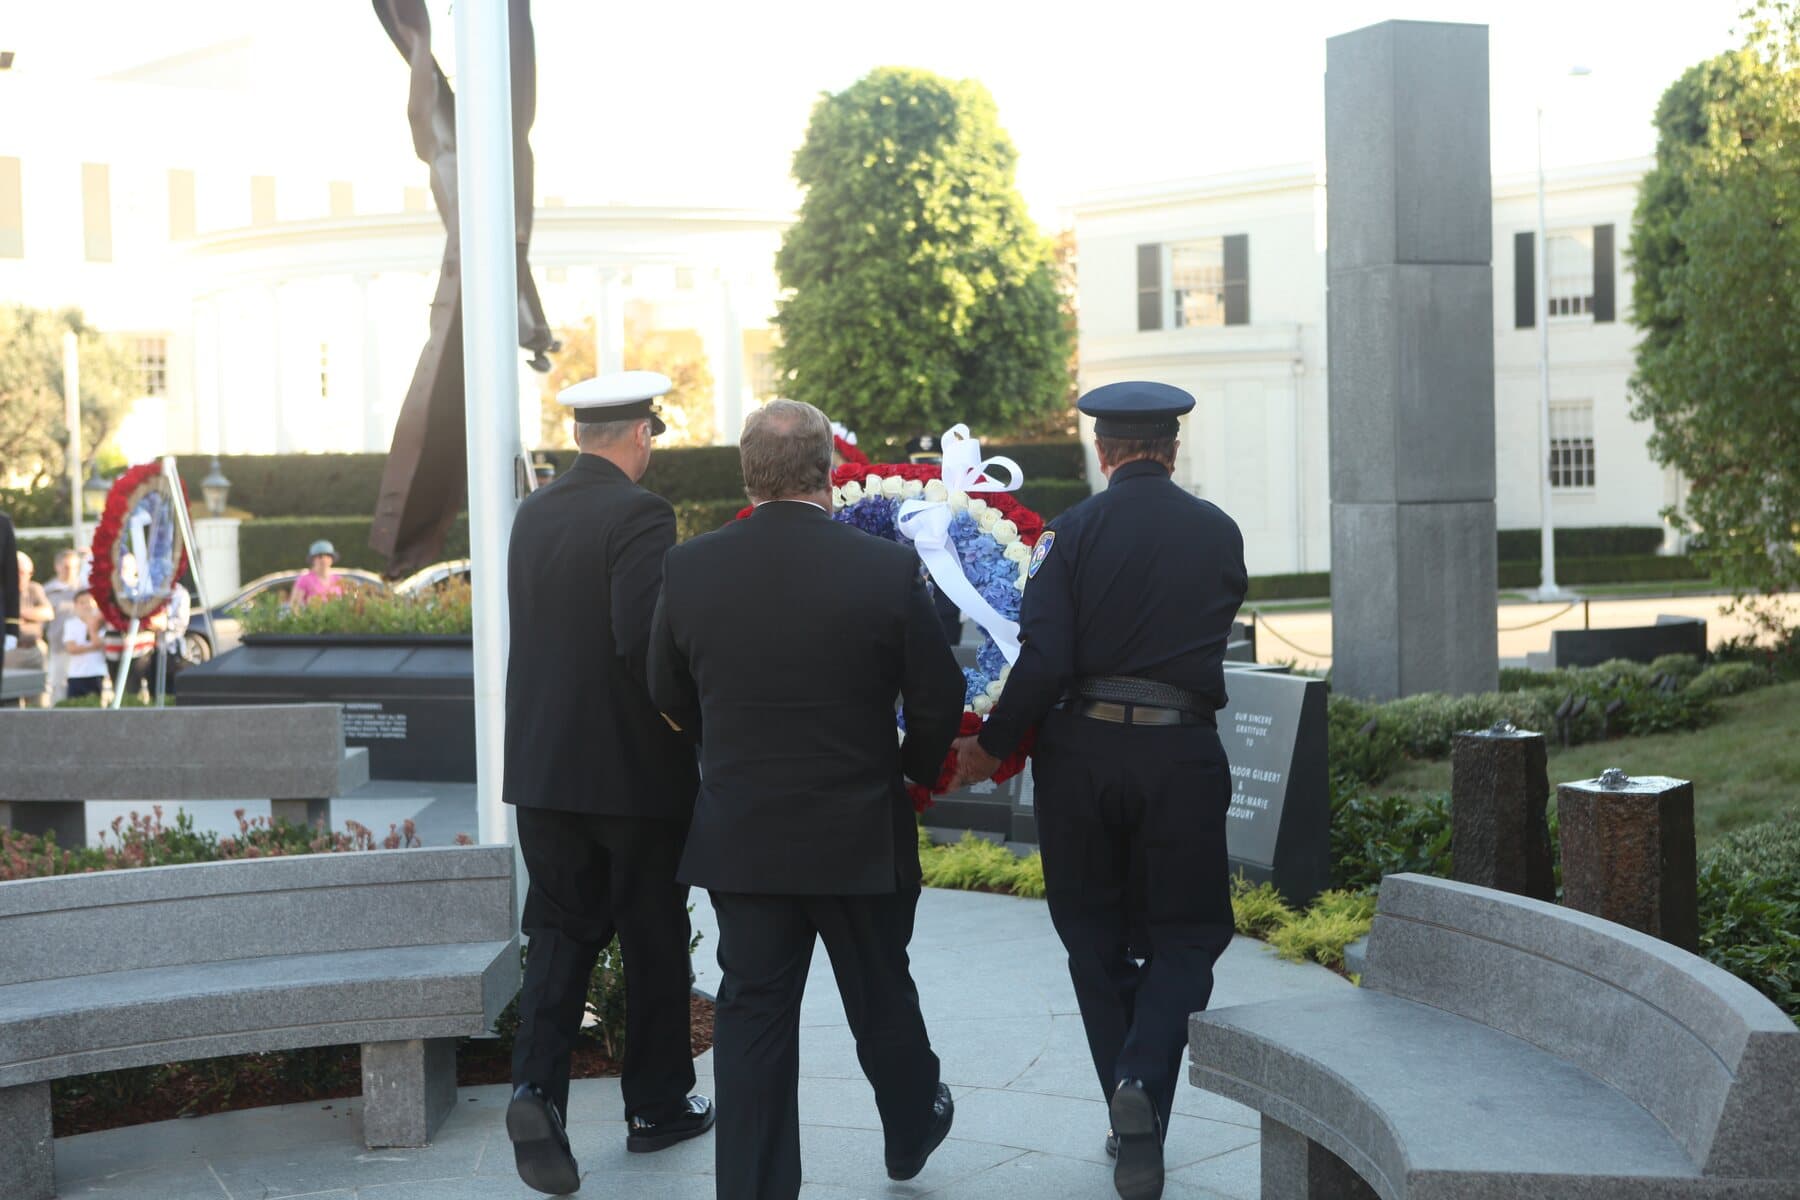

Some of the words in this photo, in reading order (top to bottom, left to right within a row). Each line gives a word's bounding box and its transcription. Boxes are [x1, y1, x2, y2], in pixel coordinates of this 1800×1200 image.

[1235, 712, 1247, 721] OUR
[1248, 714, 1272, 725] SINCERE
[1236, 725, 1267, 736] GRATITUDE
[1246, 738, 1254, 747] TO
[1252, 768, 1281, 784] GILBERT
[1231, 793, 1269, 809] OSE-MARIE
[1226, 806, 1255, 819] AGOURY
